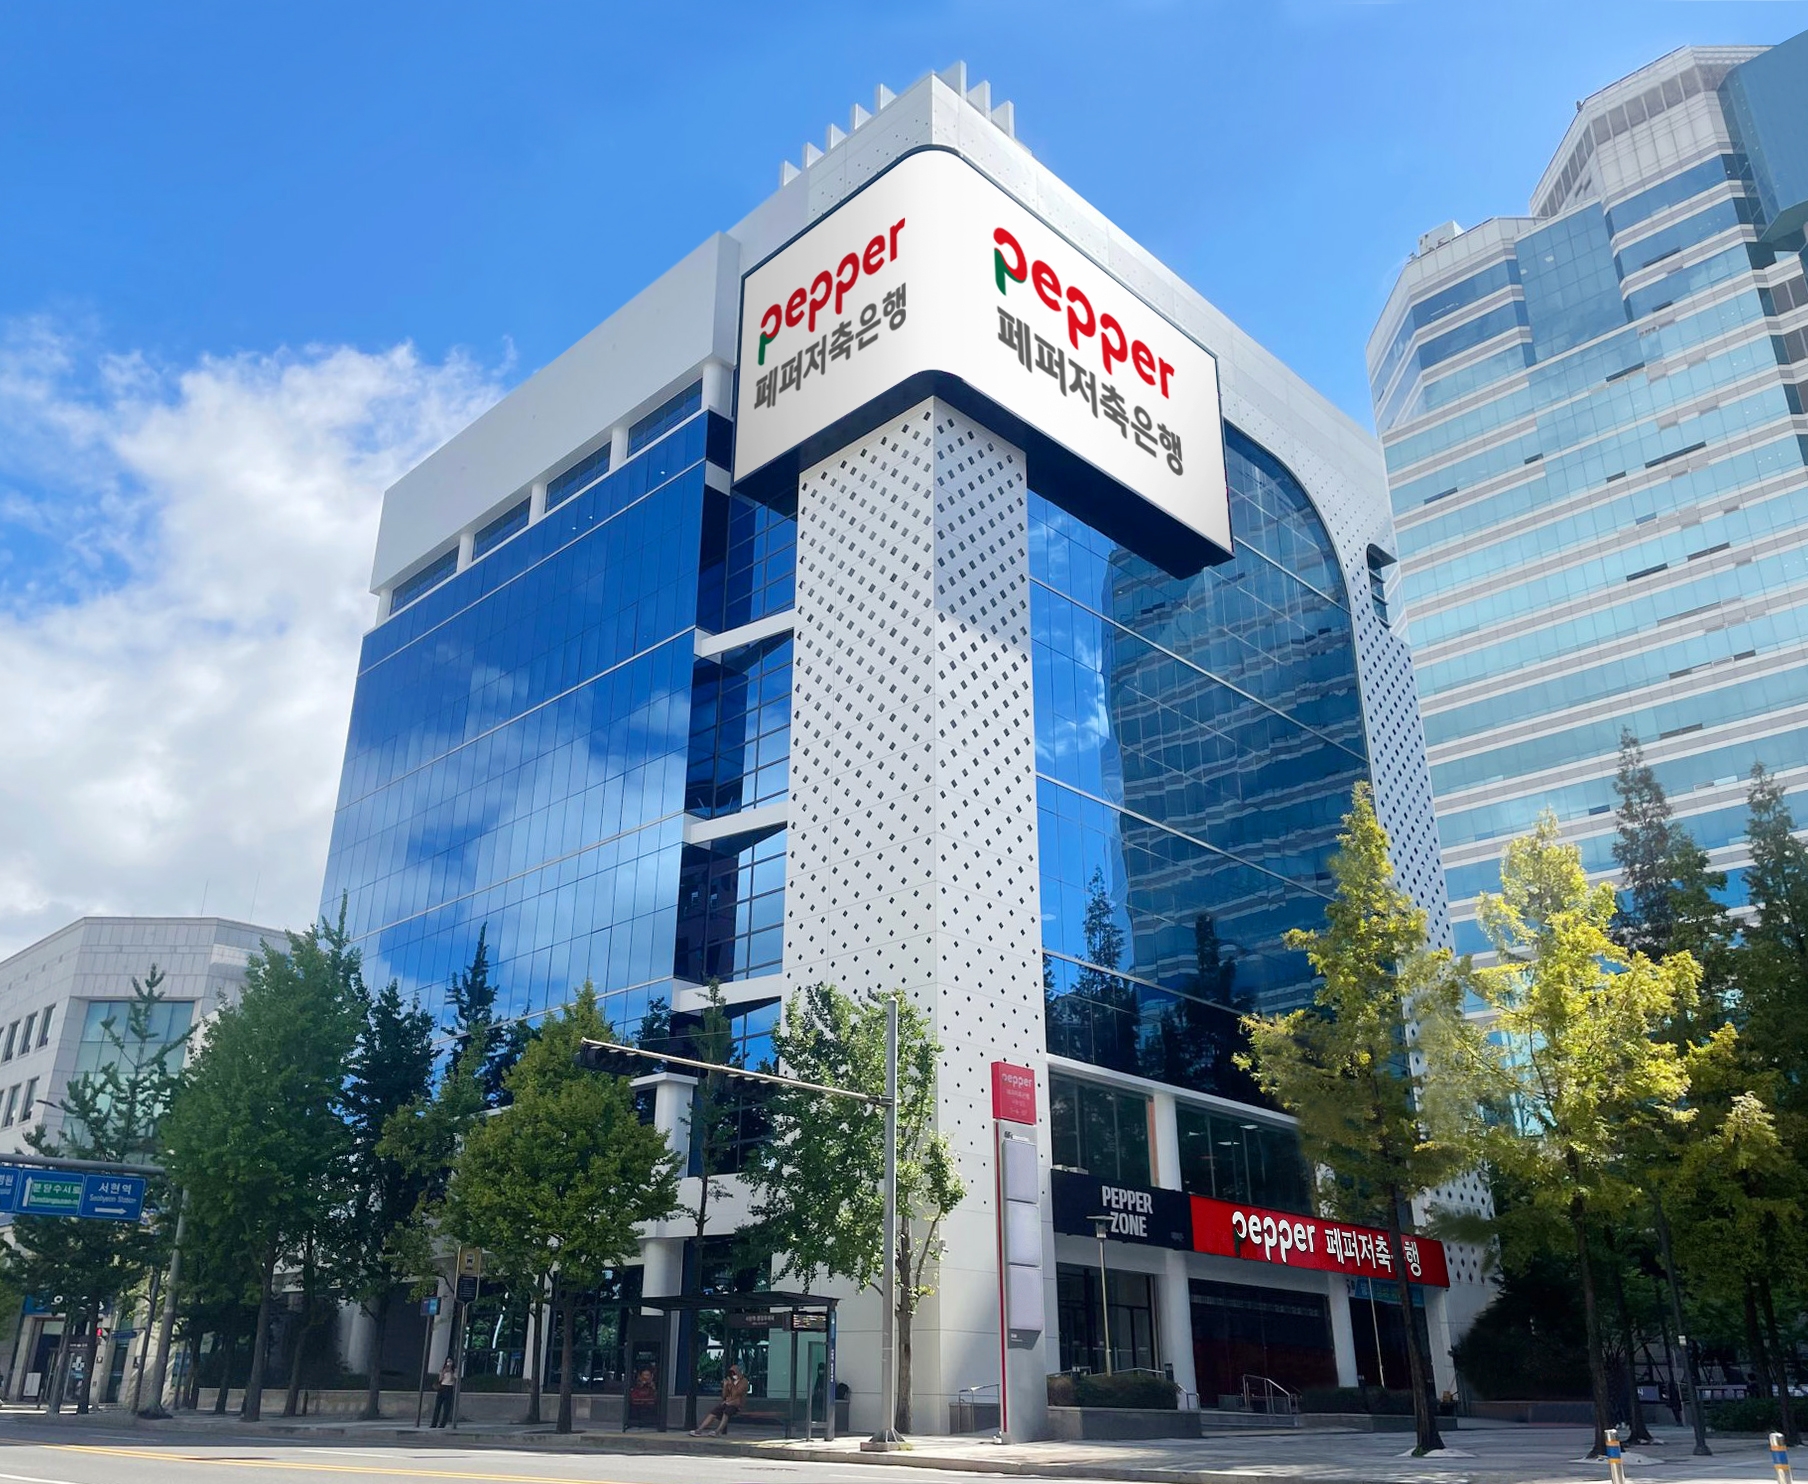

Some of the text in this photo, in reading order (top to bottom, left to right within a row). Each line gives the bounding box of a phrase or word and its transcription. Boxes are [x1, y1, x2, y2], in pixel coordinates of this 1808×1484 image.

[757, 217, 906, 366] pepper
[993, 227, 1175, 399] pepper
[754, 282, 907, 410] 페퍼저축은행
[996, 305, 1184, 476] 페퍼저축은행
[98, 1182, 132, 1195] 서현역
[1101, 1185, 1154, 1215] PEPPER
[1109, 1211, 1148, 1238] ZONE
[1232, 1210, 1422, 1277] pepper 페퍼저축행
